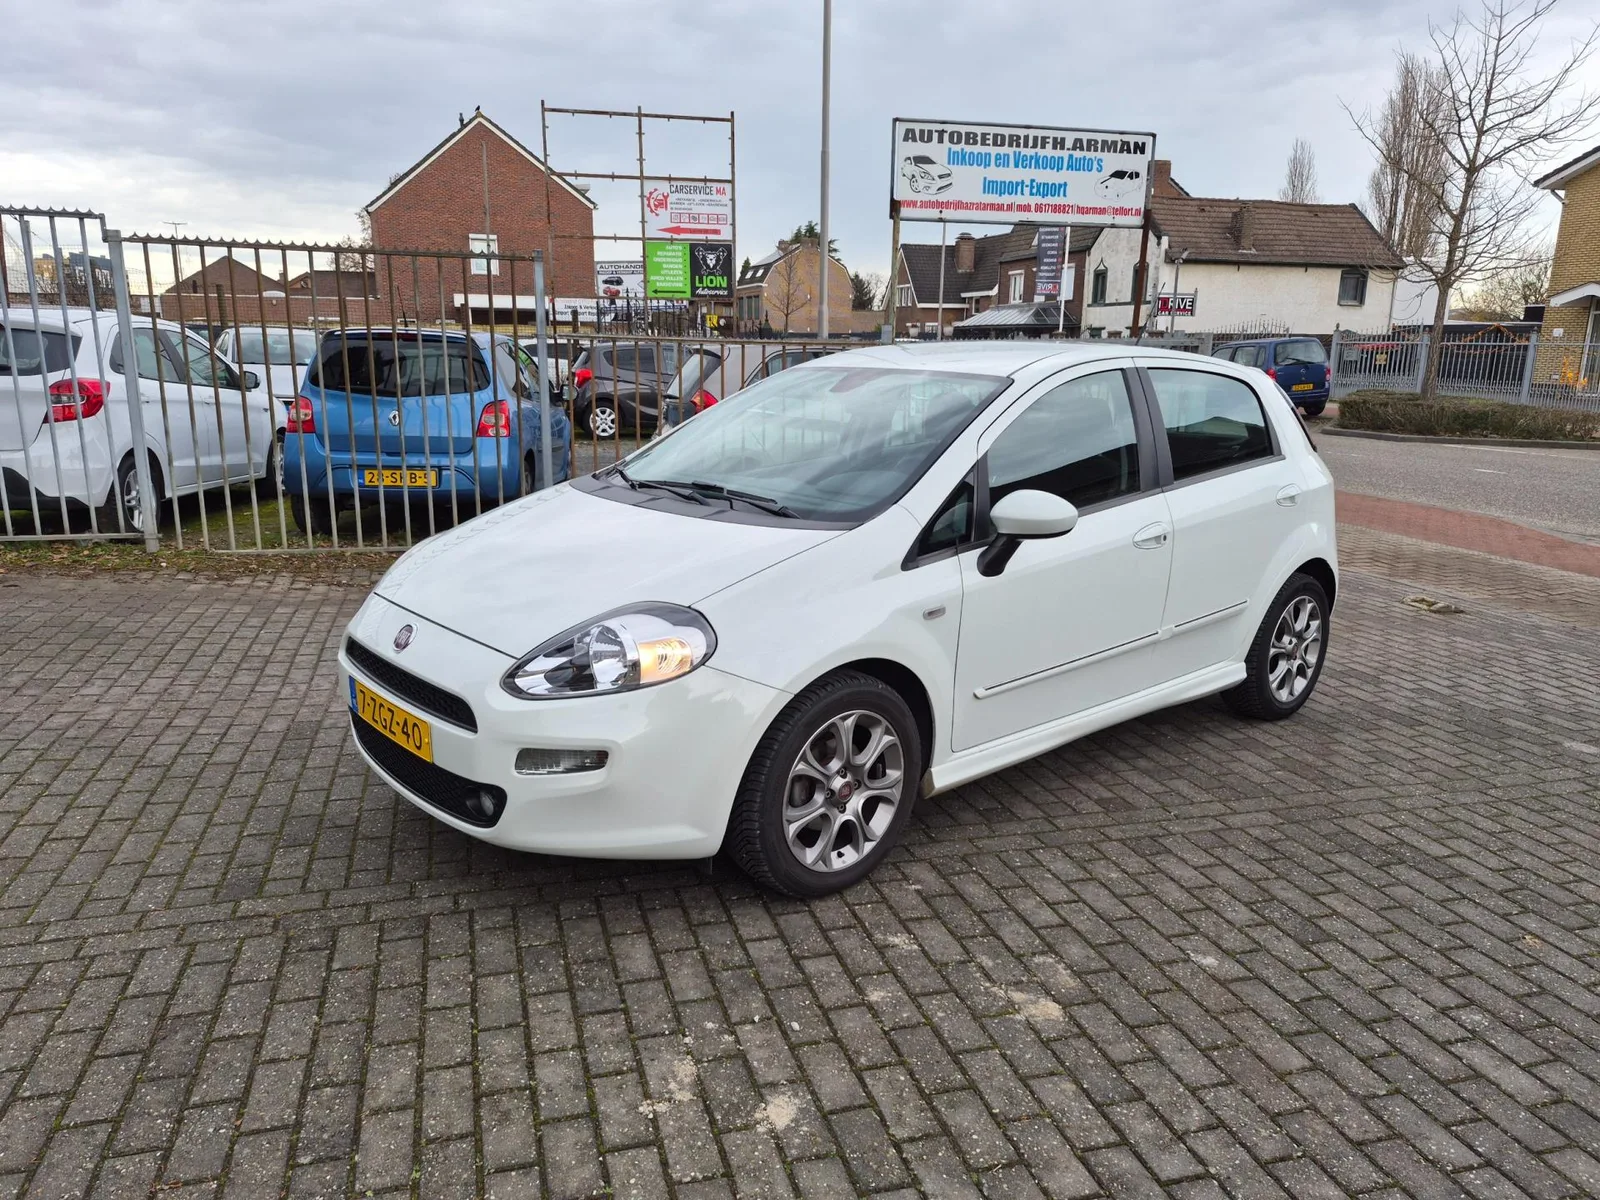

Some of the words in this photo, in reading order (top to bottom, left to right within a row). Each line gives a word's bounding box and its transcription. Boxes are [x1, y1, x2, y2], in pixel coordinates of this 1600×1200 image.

[902, 127, 1146, 155] AUTOBEDRIJFH.ARMAN
[947, 147, 991, 169] Inkoop
[994, 152, 1010, 168] en
[1013, 150, 1064, 172] Verkoop
[1066, 153, 1103, 173] Auto's
[669, 184, 714, 196] CARSERVICE
[715, 186, 727, 196] MA
[982, 176, 1068, 198] Import-Export
[695, 275, 728, 288] LION
[359, 689, 422, 751] 7-ZGZ-40
